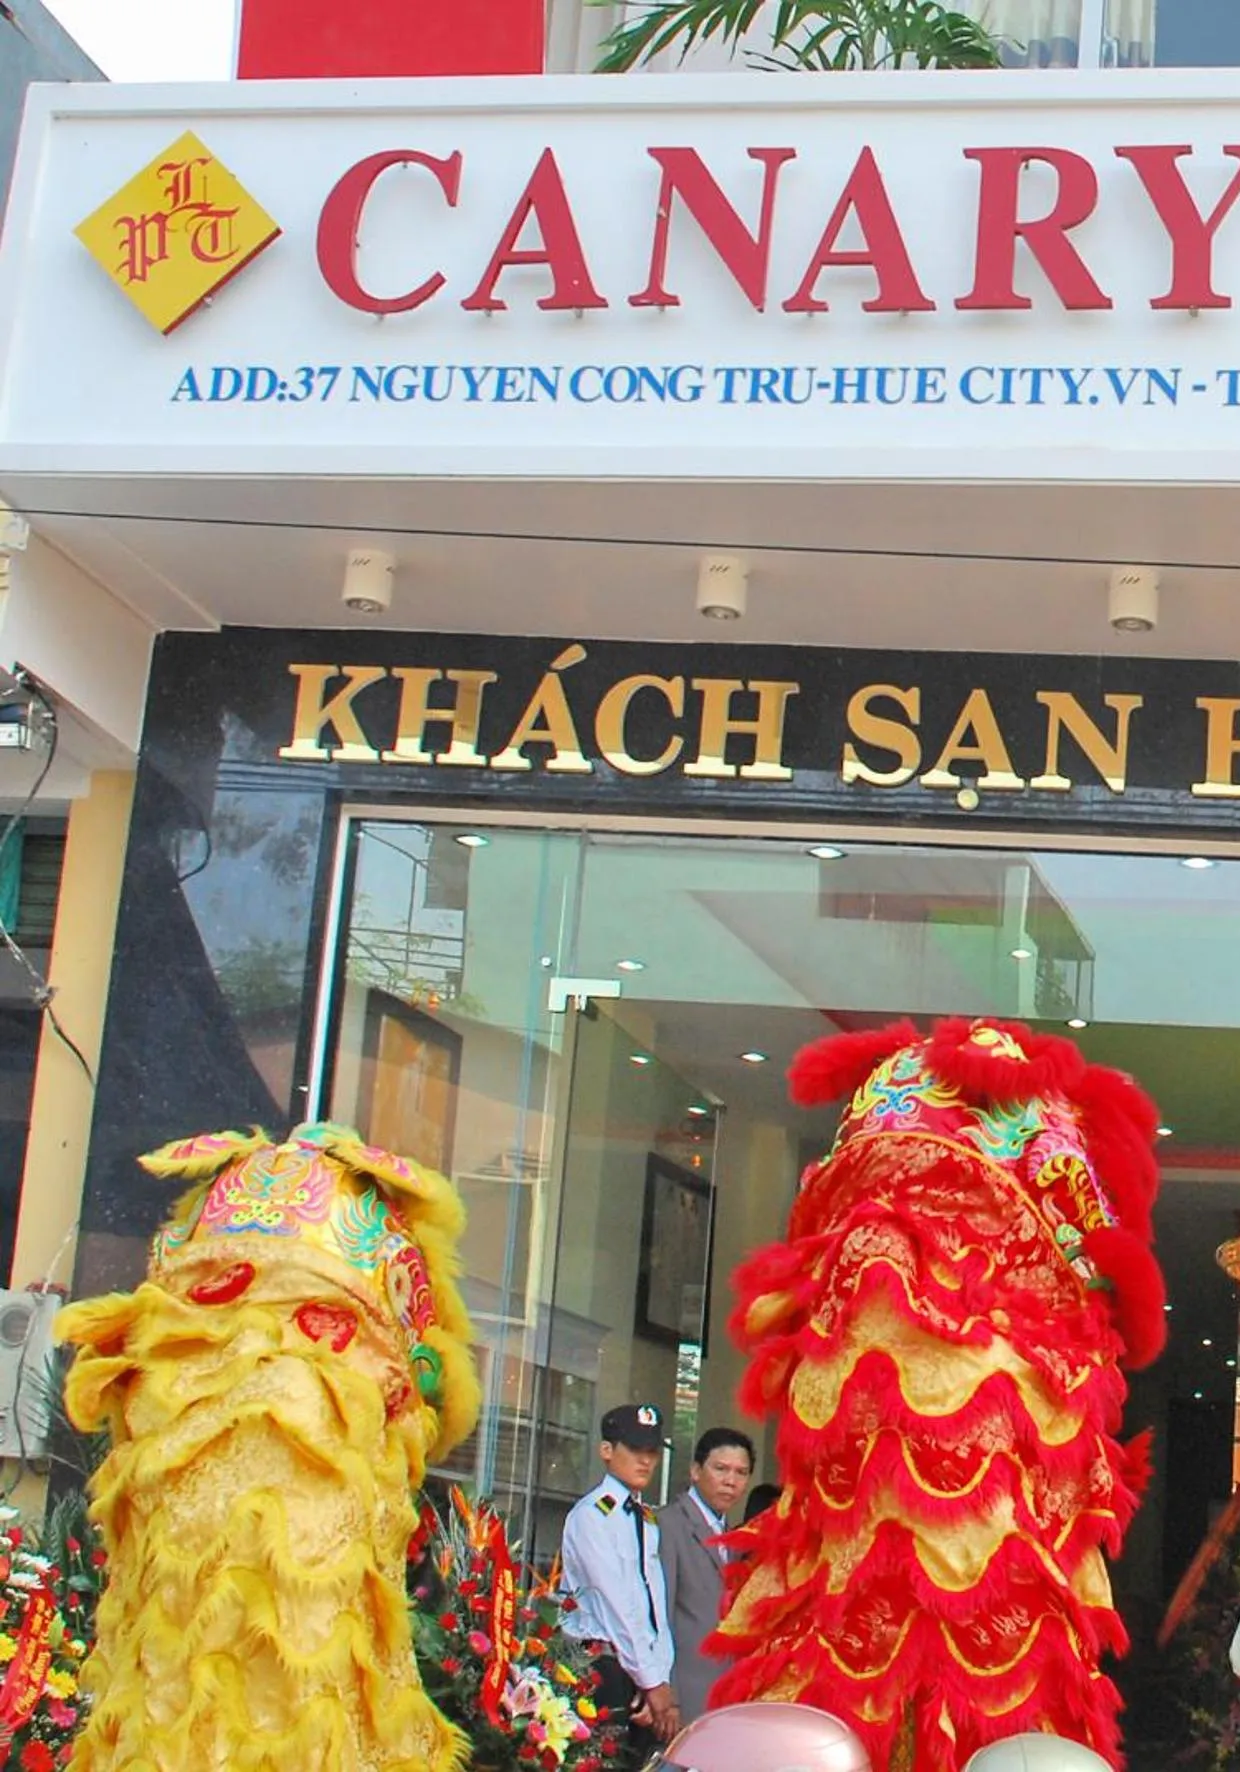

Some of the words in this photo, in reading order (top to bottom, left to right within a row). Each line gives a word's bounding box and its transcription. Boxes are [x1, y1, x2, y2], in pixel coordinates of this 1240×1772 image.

[350, 363, 563, 403] NGUYEN
[568, 363, 706, 403] CONG
[713, 364, 947, 405] TRU-HUE
[959, 365, 1182, 406] CITY.VN
[278, 643, 800, 780] KHÁCH
[842, 683, 1144, 812] SẠN
